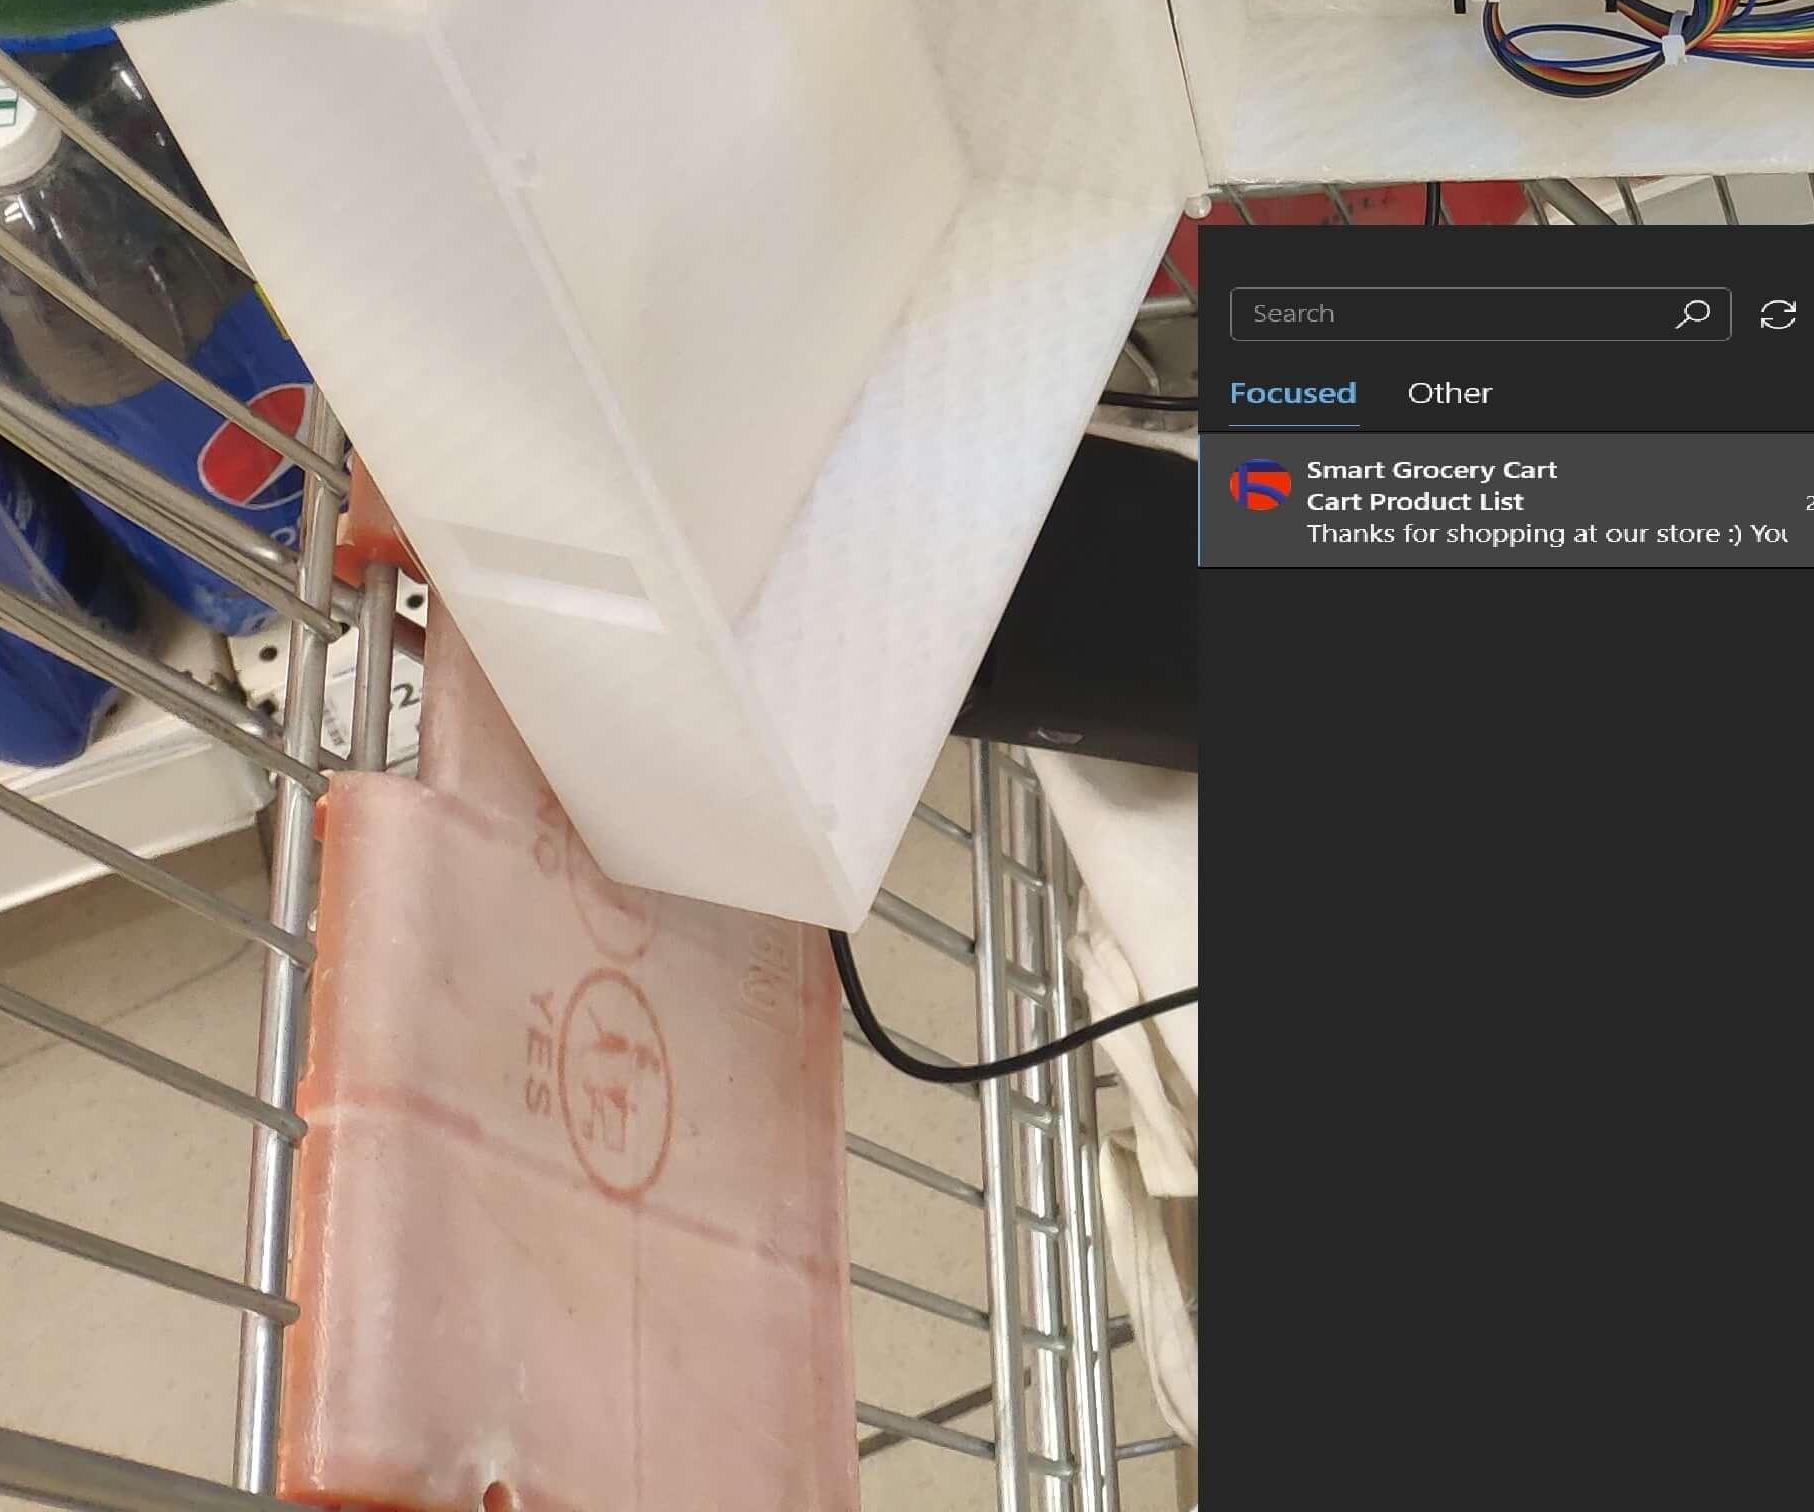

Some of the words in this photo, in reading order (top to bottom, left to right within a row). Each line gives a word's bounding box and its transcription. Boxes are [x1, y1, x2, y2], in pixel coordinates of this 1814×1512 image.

[1254, 303, 1335, 323] Search
[1231, 381, 1357, 404] Focused
[1408, 381, 1494, 404] Other
[1307, 461, 1386, 480] Smart
[1391, 461, 1497, 484] Grocery
[1503, 461, 1558, 479] Cart
[1306, 493, 1363, 513] Cart
[1370, 491, 1473, 512] Product
[1479, 491, 1525, 513] List
[1306, 523, 1395, 544] Thanks
[1402, 523, 1441, 544] for
[1446, 523, 1565, 548] shopping
[1573, 524, 1598, 544] at
[1605, 527, 1650, 544] our
[1656, 524, 1721, 543] store
[1728, 524, 1742, 547] :)
[523, 989, 556, 1117] YES
